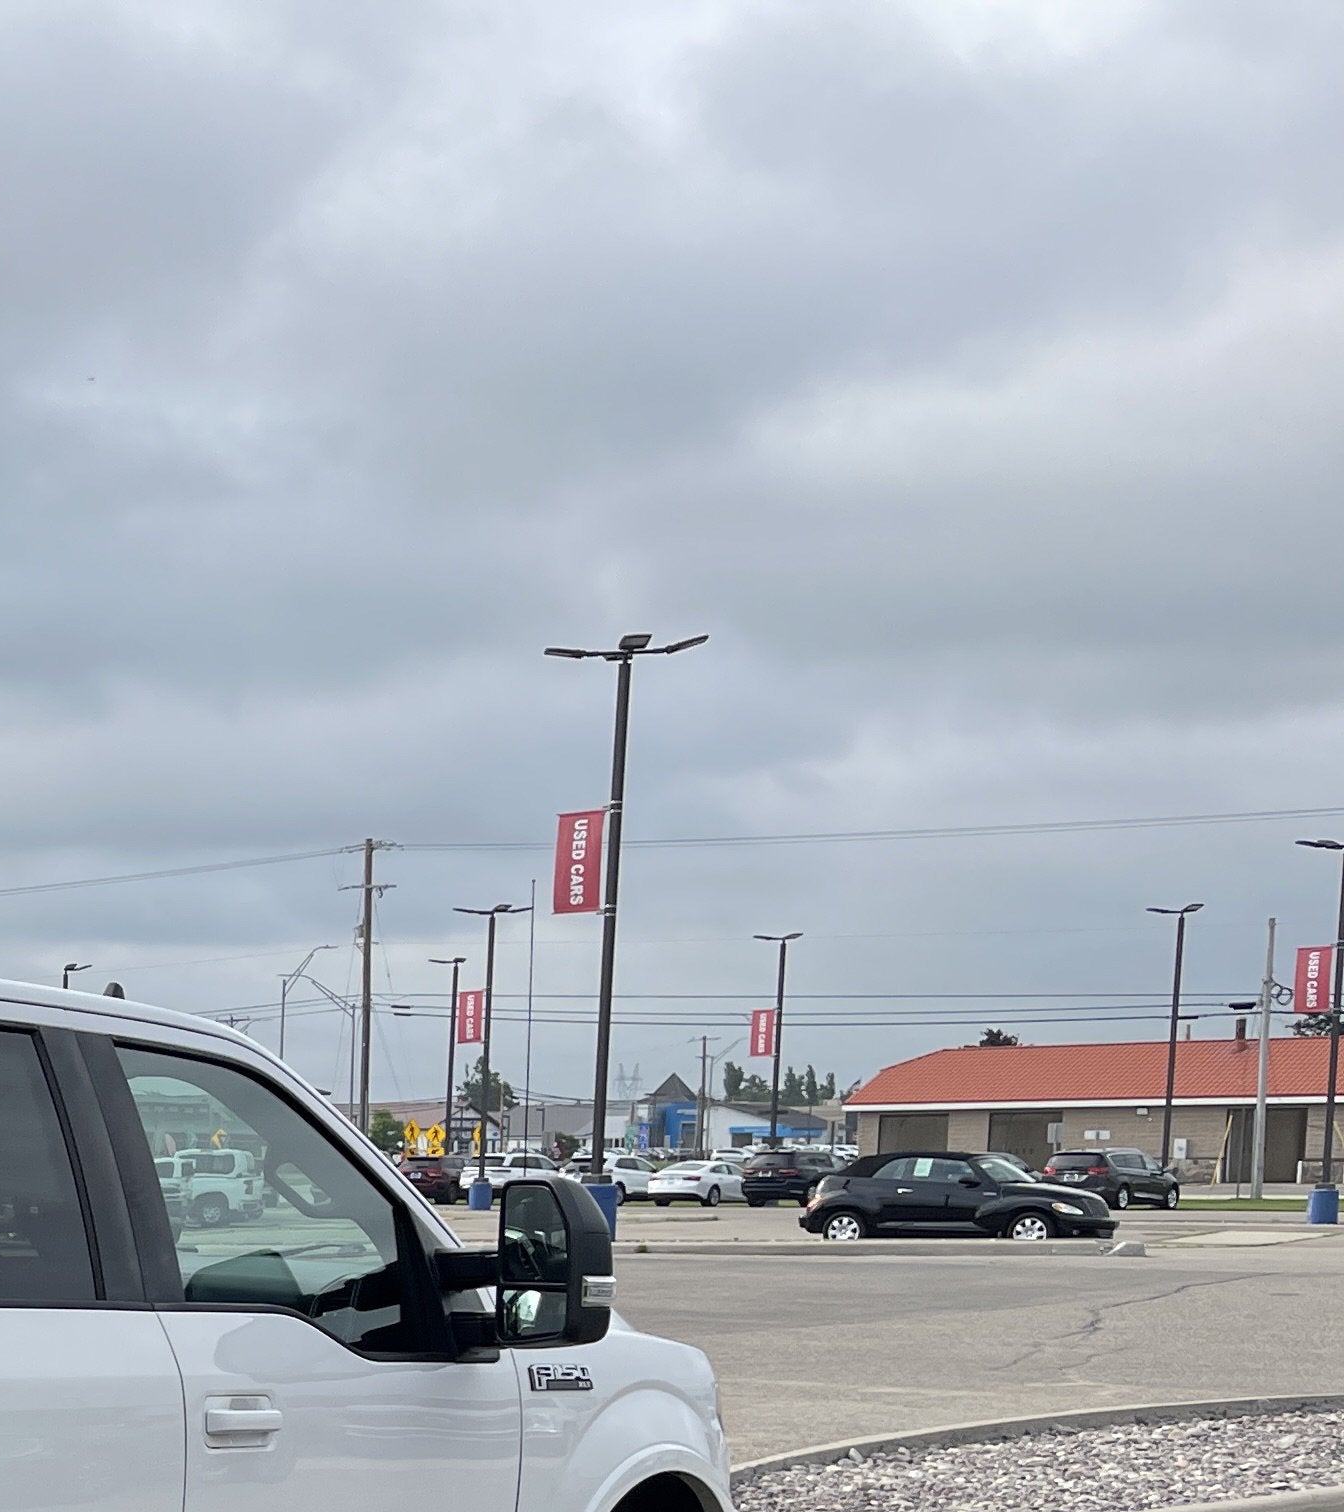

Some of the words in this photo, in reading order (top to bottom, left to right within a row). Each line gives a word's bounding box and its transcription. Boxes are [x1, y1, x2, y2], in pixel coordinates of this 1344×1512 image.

[572, 819, 589, 860] USED
[569, 864, 585, 905] CARS
[1306, 951, 1321, 979] USED
[1306, 980, 1318, 1008] CARS
